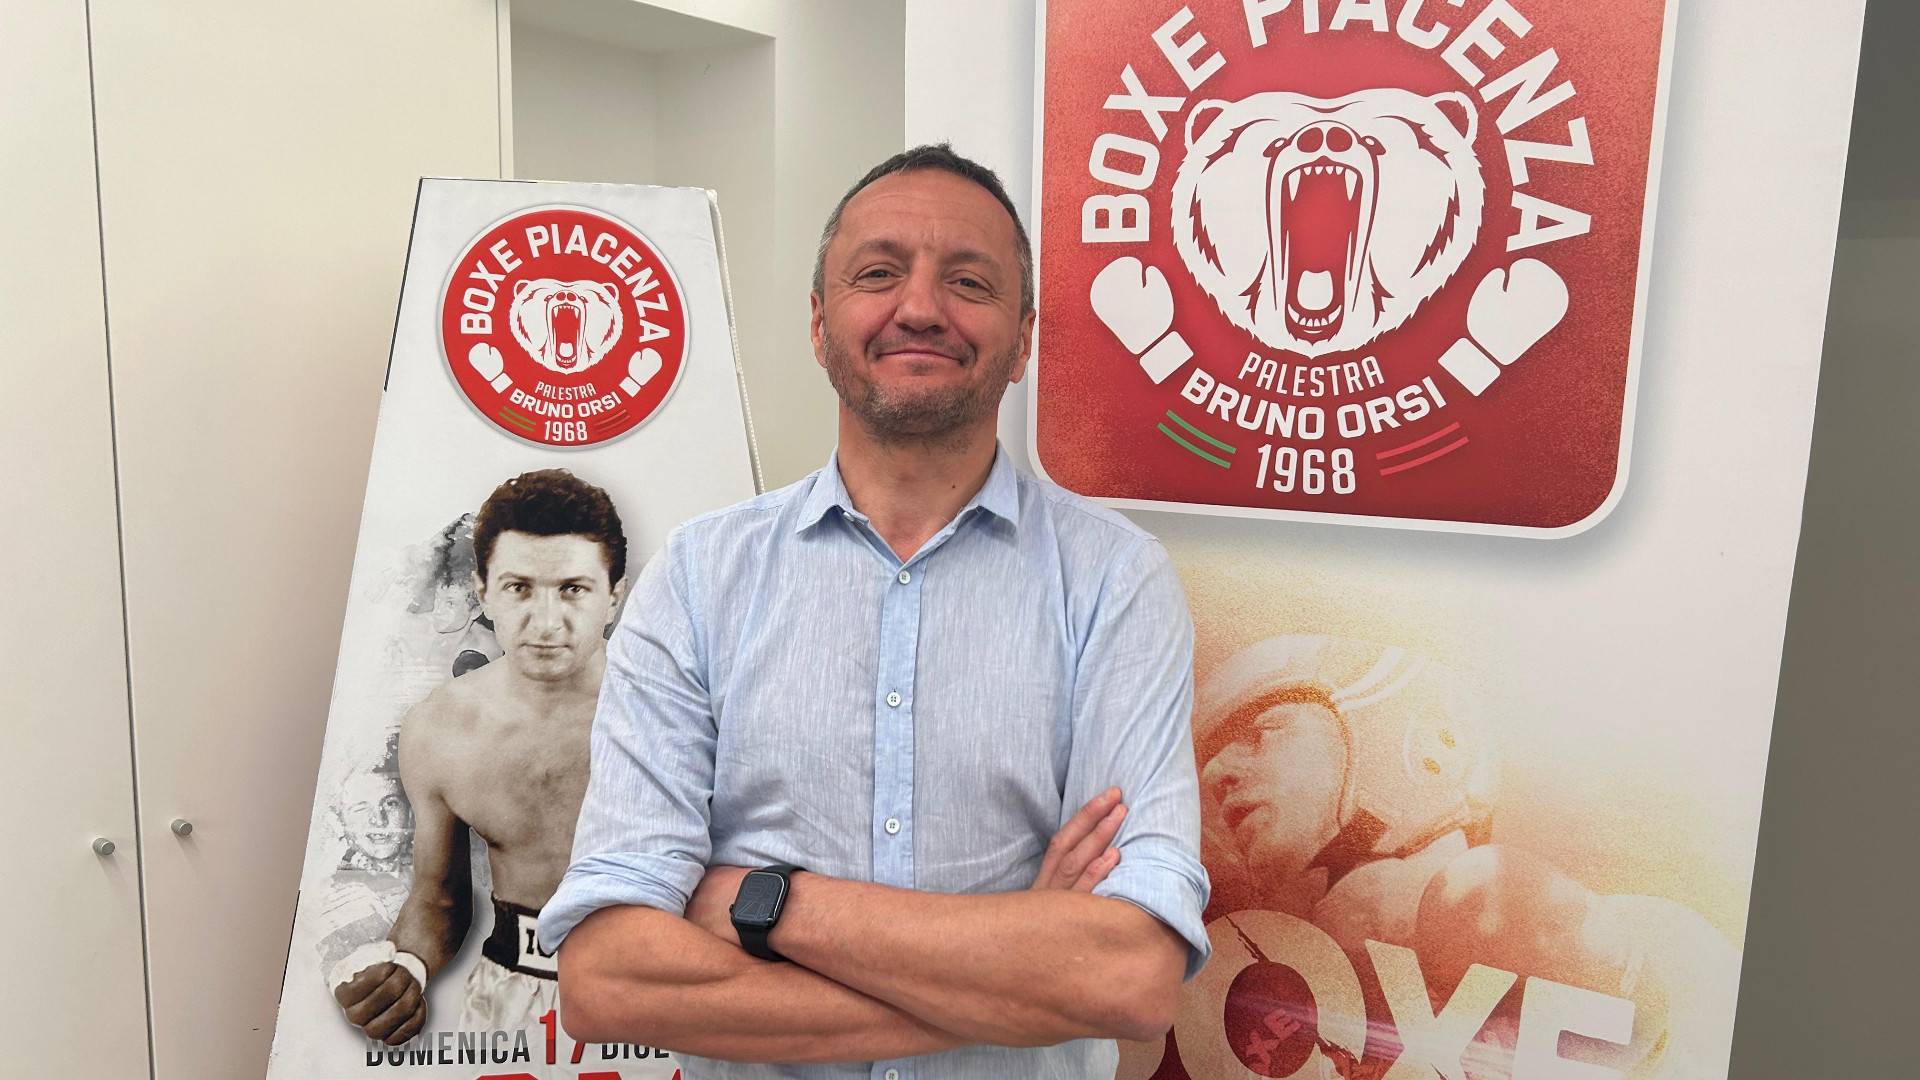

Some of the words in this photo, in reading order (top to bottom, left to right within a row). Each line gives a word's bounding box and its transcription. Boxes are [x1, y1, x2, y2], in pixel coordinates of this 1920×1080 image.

[1081, 5, 1227, 244] BOXE
[461, 238, 523, 335] BOXE
[525, 223, 670, 343] PIACENZA
[534, 381, 597, 401] PALESTRA
[1238, 352, 1385, 397] PALESTRA
[509, 388, 574, 419] BRUNO
[577, 391, 622, 418] ORSI
[1180, 367, 1325, 440] BRUNO
[1336, 376, 1447, 439] ORSI
[544, 420, 588, 442] 1968
[1255, 443, 1356, 495] 1968
[366, 1030, 531, 1067] DOMENICA
